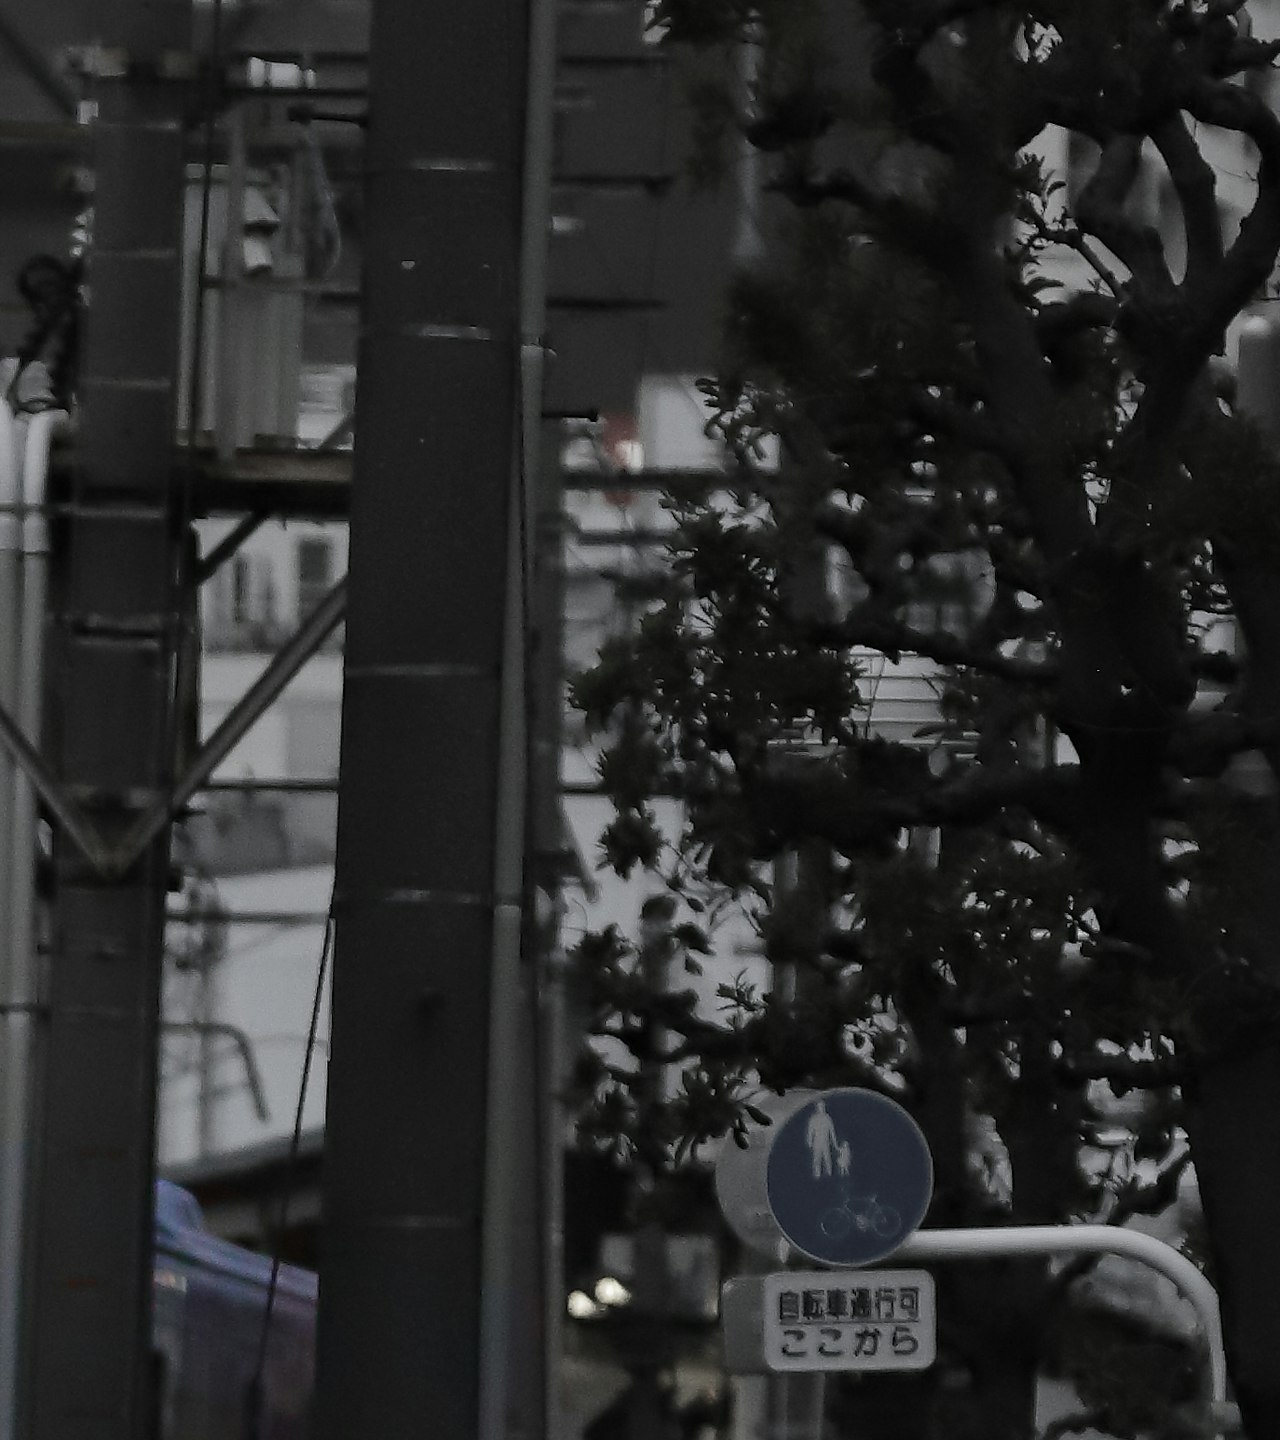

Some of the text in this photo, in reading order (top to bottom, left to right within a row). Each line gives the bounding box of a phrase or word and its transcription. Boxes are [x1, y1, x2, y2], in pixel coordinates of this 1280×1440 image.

[780, 1287, 919, 1320] 自転車通行可
[782, 1326, 919, 1357] ここから
